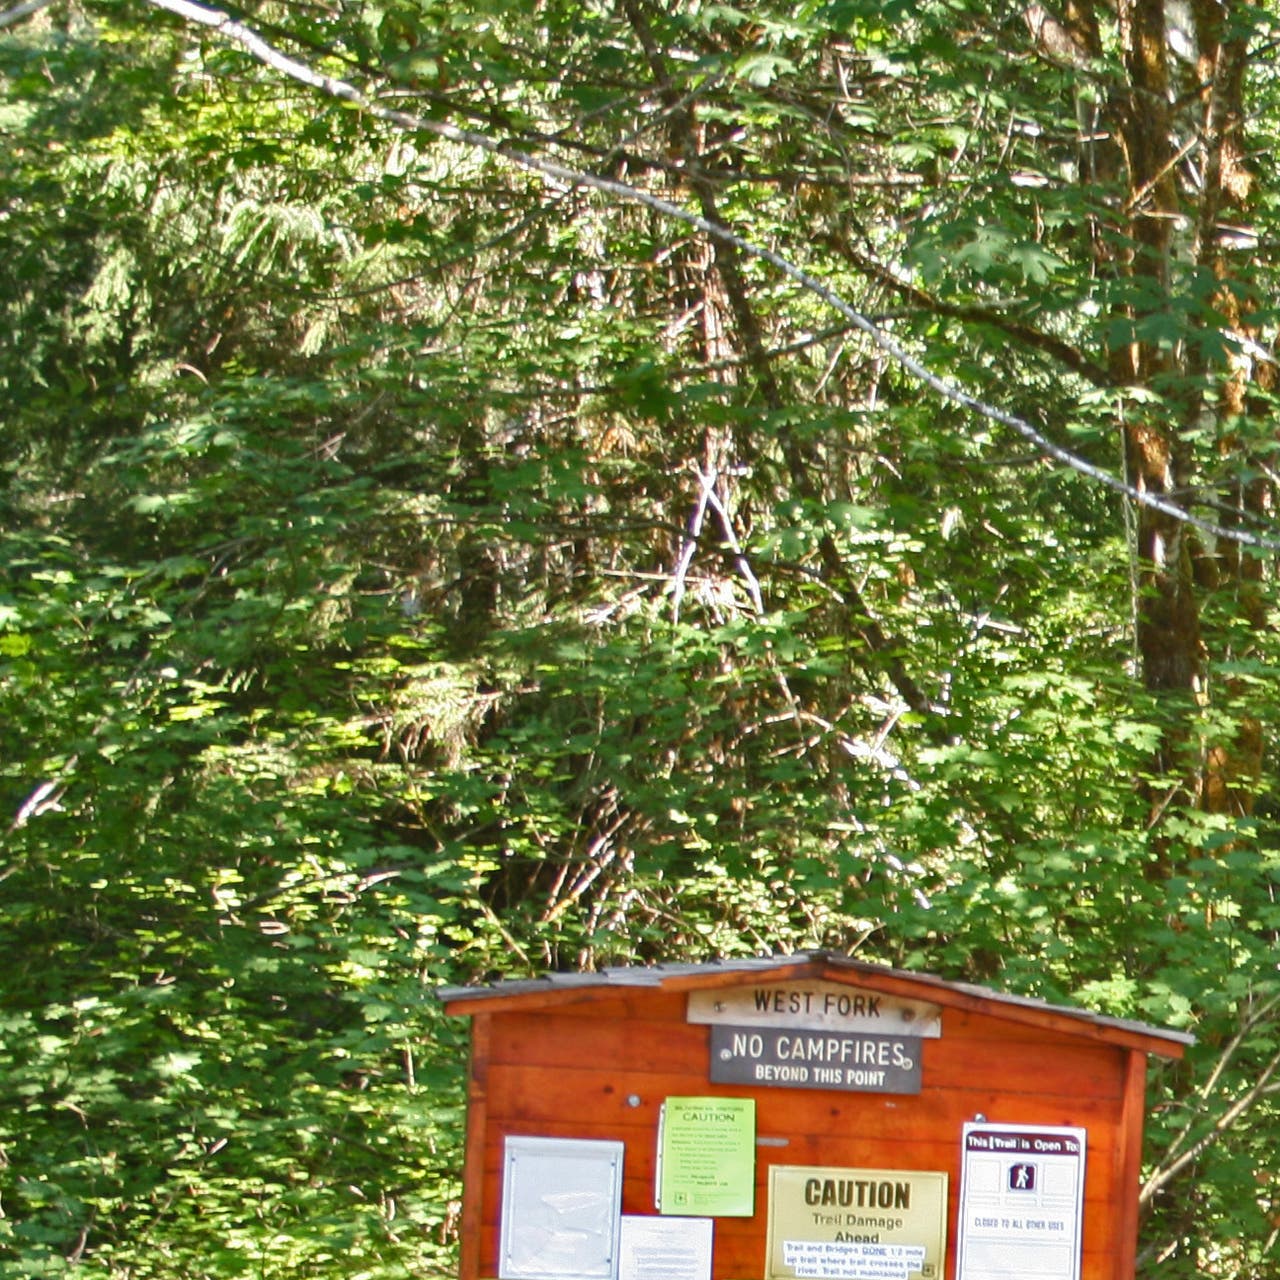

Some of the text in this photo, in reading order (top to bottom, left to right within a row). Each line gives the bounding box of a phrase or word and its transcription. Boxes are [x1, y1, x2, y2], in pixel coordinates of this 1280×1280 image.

[754, 989, 880, 1017] WEST FORK
[733, 1033, 905, 1066] NO CAMPFIRES
[755, 1065, 885, 1086] BEYOND THIS POINT
[683, 1113, 735, 1122] CAUTION
[968, 1135, 988, 1147] This
[994, 1138, 1016, 1149] Trail
[1021, 1138, 1030, 1149] is
[1034, 1139, 1061, 1151] Open
[805, 1178, 910, 1209] CAUTION
[812, 1213, 903, 1230] Trail Damage
[974, 1217, 998, 1228] CLOSED
[1002, 1219, 1010, 1229] TO
[1013, 1219, 1023, 1229] ALL
[1026, 1220, 1045, 1230] OTHER
[835, 1232, 879, 1244] Ahead
[787, 1243, 803, 1252] Trail
[806, 1244, 822, 1252] and
[825, 1244, 858, 1255] Bridges
[787, 1254, 920, 1269] up trail where trail crosses the
[823, 1267, 840, 1275] Trail
[843, 1267, 857, 1276] not
